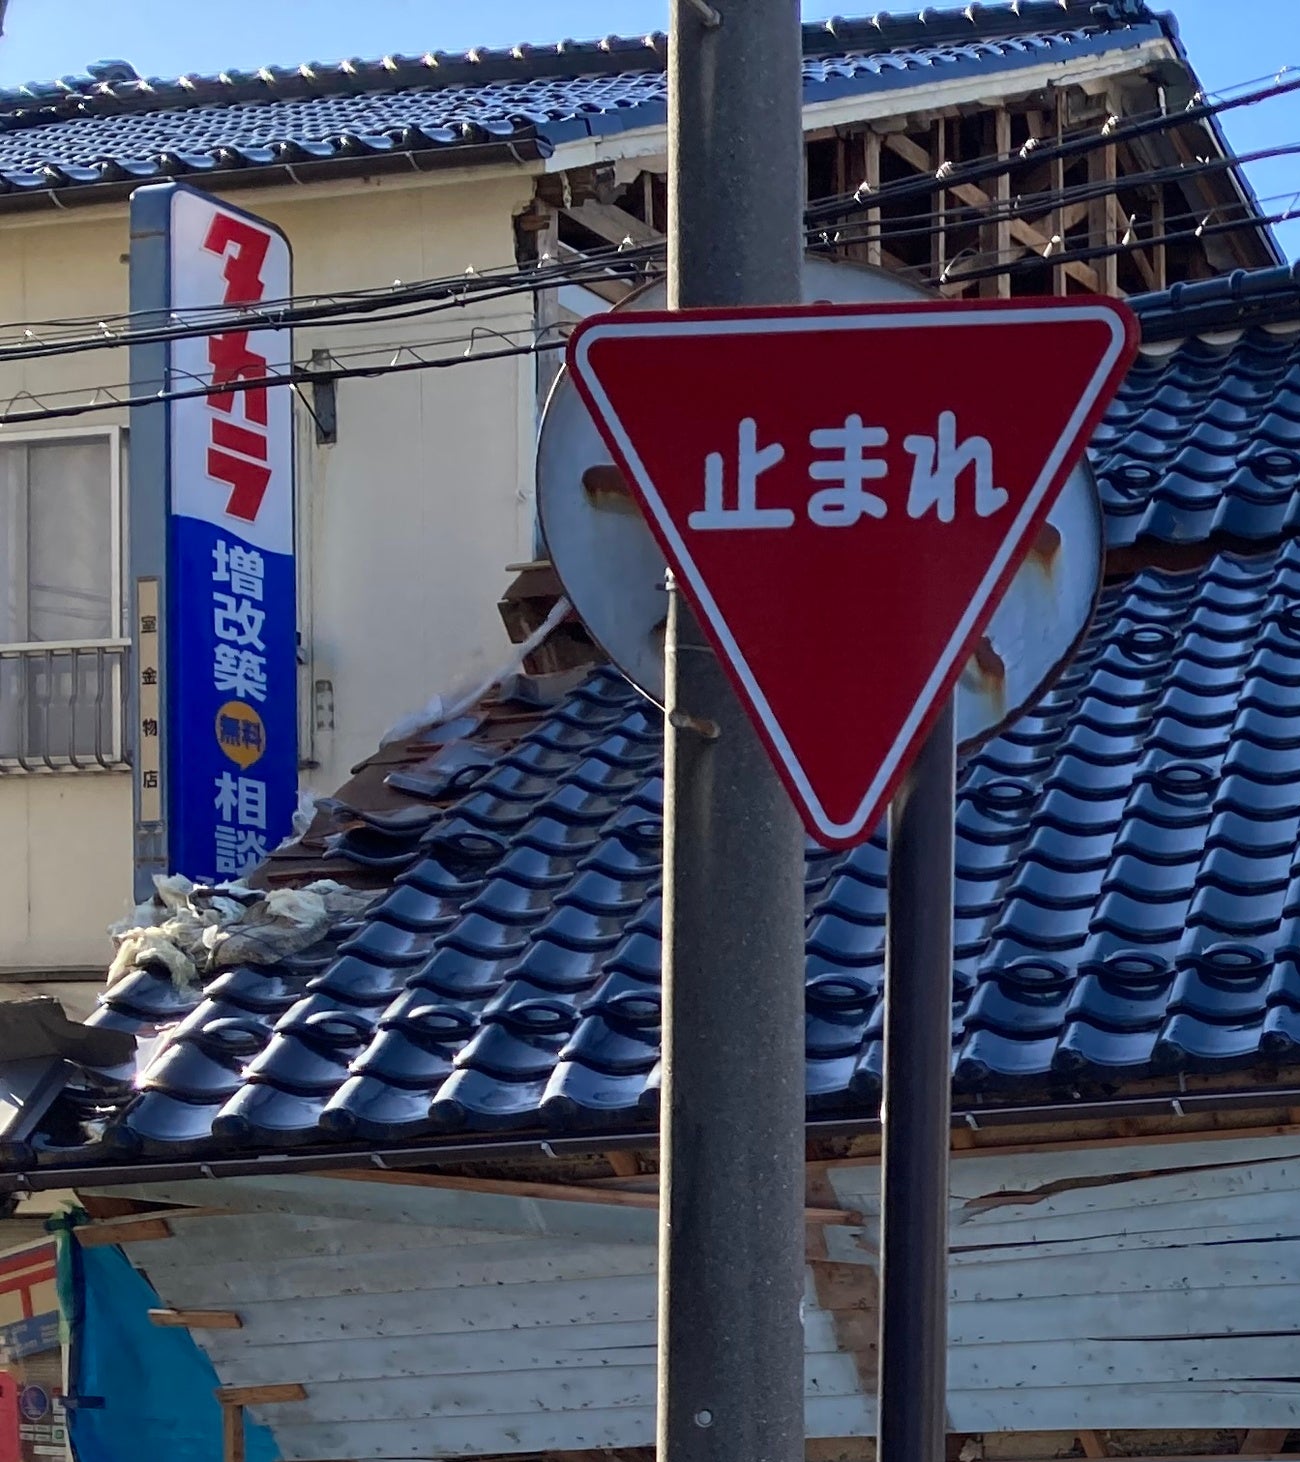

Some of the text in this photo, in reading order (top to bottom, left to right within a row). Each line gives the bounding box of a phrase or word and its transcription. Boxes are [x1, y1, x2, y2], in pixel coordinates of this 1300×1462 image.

[204, 211, 272, 522] タカラ
[688, 410, 1009, 530] 止まれ
[211, 540, 267, 702] 増改築
[140, 614, 158, 789] 室金物店
[219, 713, 262, 752] 無料
[213, 771, 268, 876] 相談
